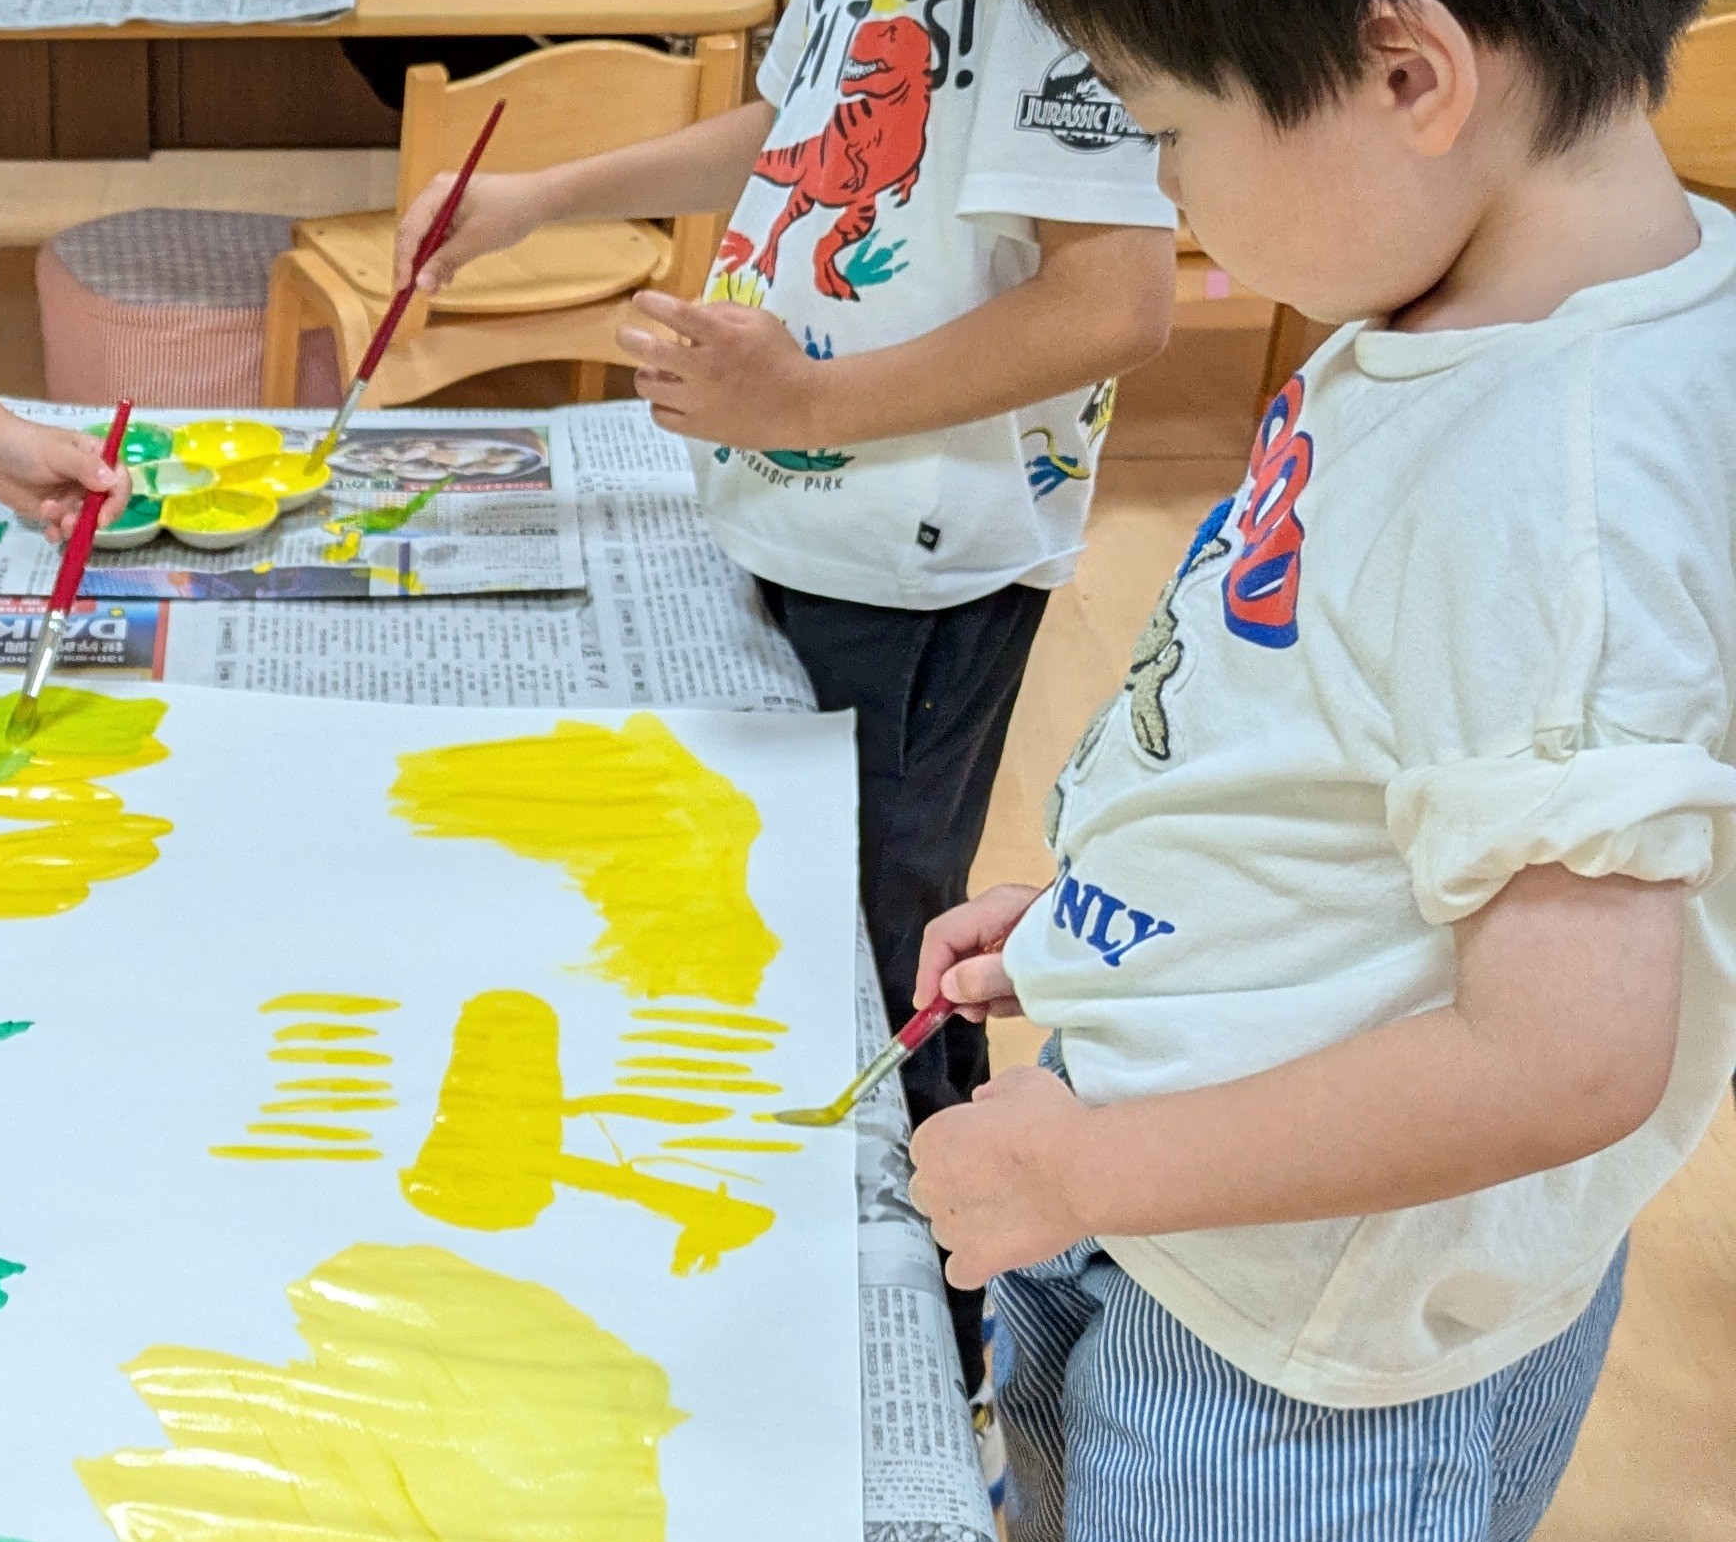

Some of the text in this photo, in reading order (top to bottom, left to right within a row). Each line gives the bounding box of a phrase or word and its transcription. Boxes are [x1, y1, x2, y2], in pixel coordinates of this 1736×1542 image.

[1021, 97, 1106, 131] JURASSIC
[735, 447, 844, 492] URASSIC PARK
[1053, 855, 1175, 967] NLY
